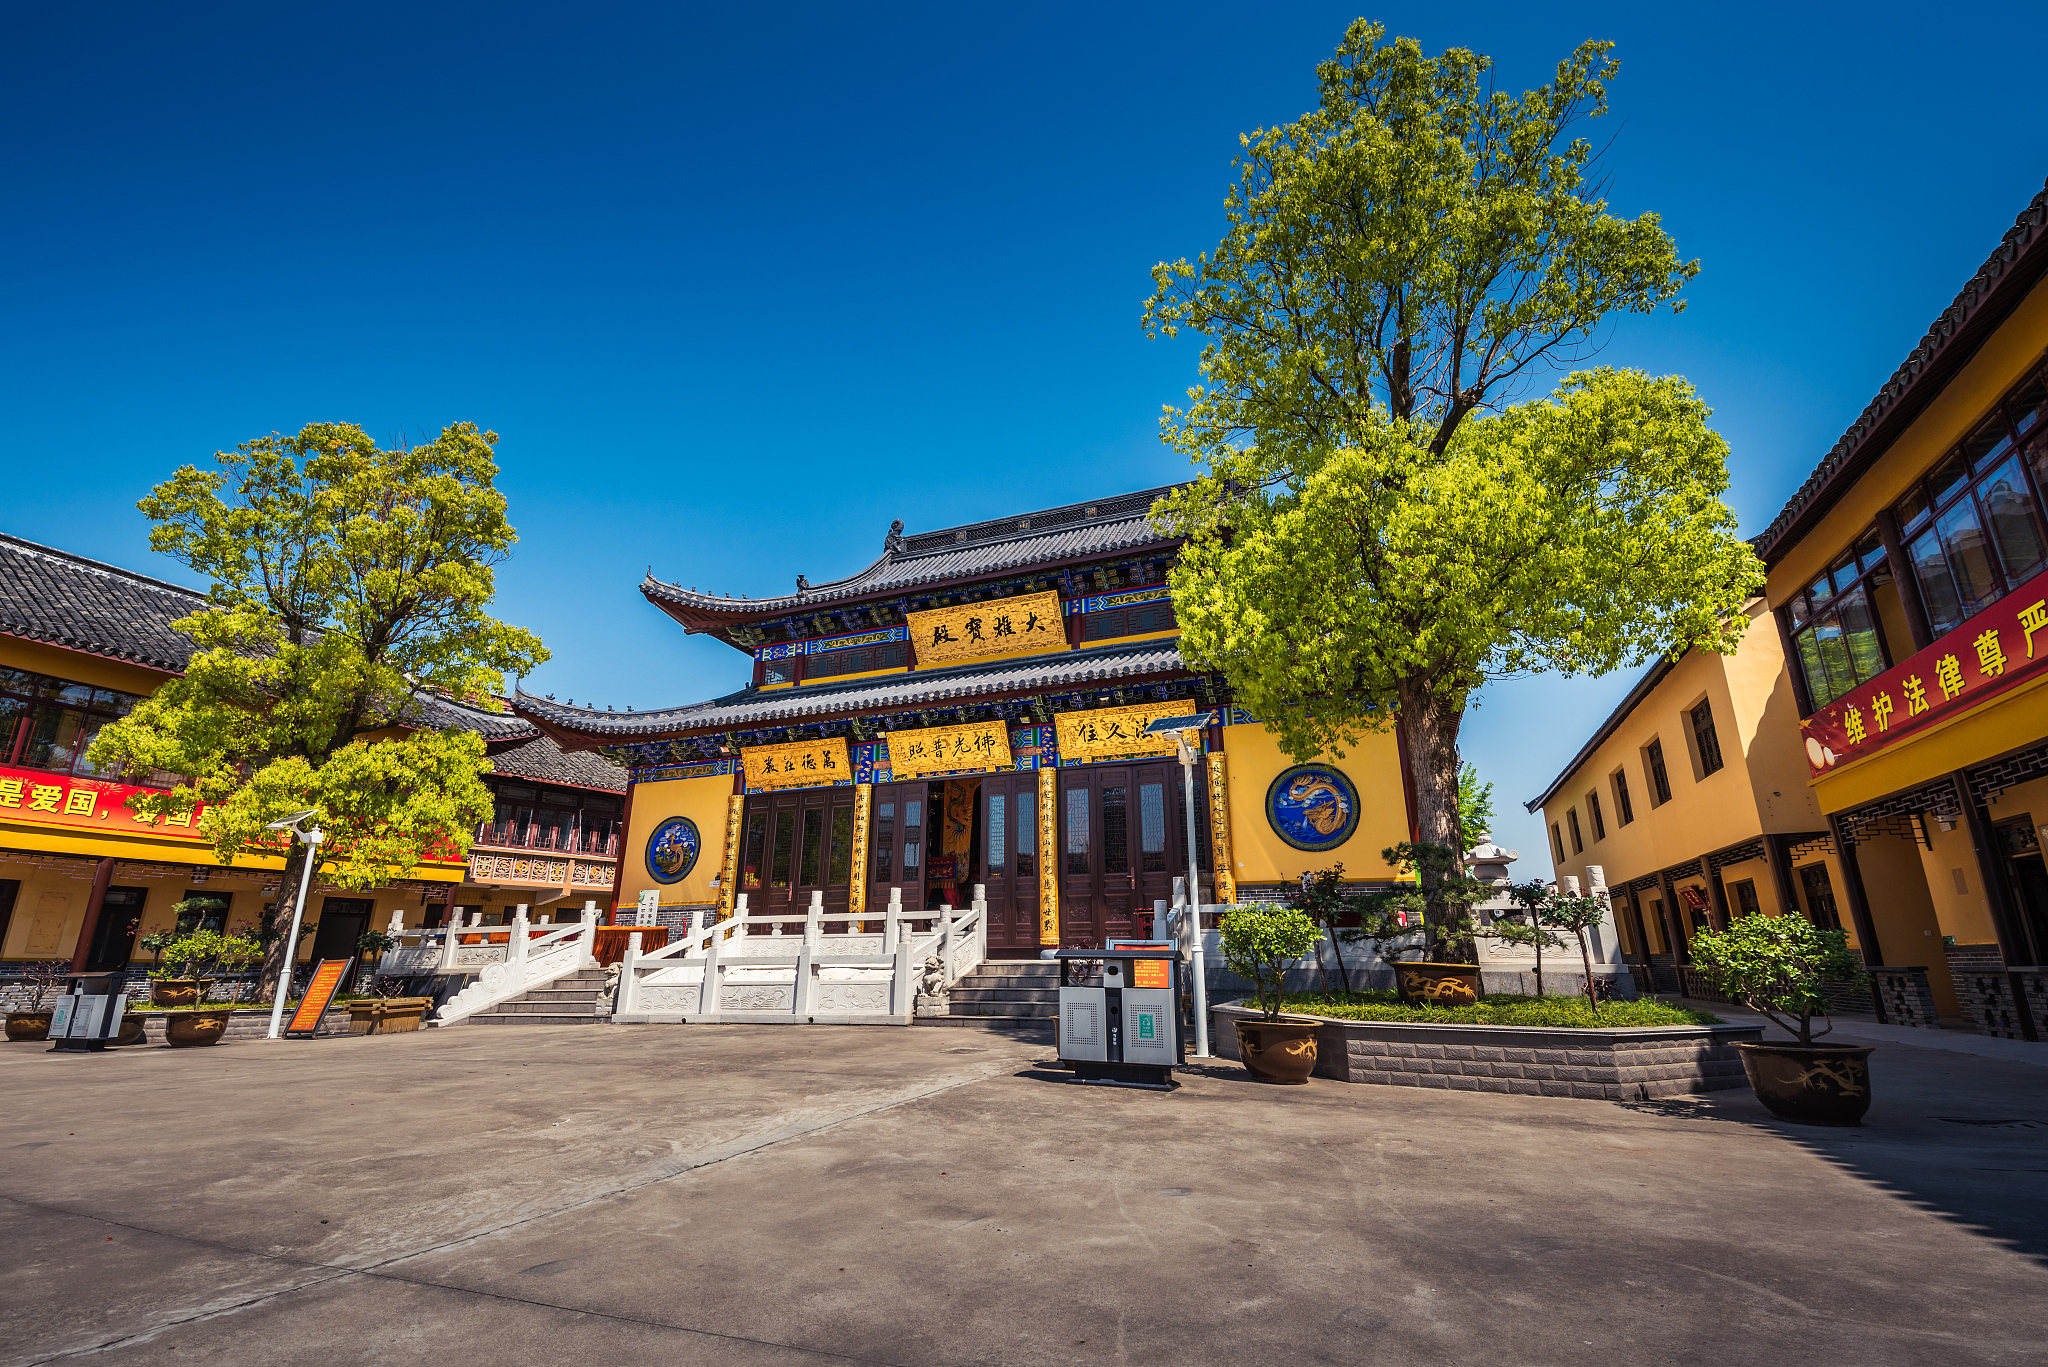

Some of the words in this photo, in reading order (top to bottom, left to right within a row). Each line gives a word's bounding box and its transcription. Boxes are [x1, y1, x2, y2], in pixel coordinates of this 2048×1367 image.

[1844, 598, 2048, 746] 维护法律尊严
[1078, 716, 1178, 743] 法久住
[907, 731, 996, 762] 佛光普照
